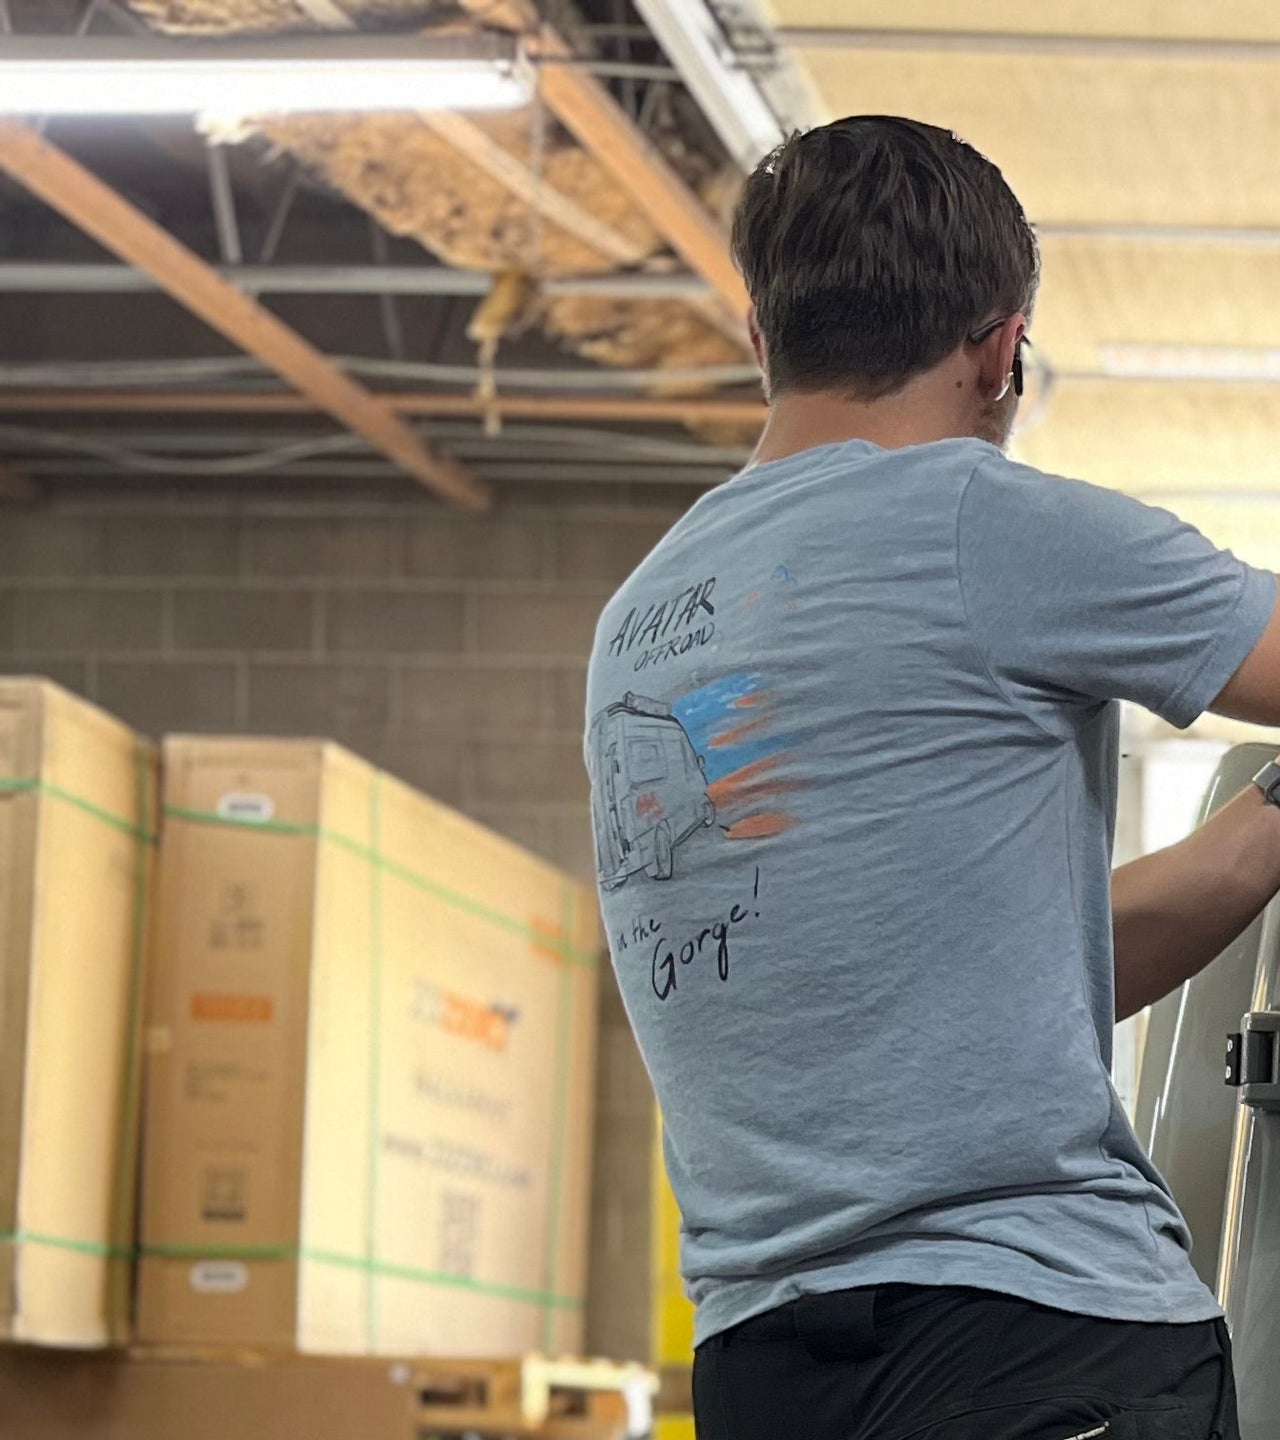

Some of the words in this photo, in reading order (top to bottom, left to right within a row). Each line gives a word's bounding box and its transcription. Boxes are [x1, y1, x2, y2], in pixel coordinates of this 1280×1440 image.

[608, 577, 716, 657] AVATAR
[633, 621, 716, 672] OFFROAD
[651, 866, 761, 1001] Gorge!
